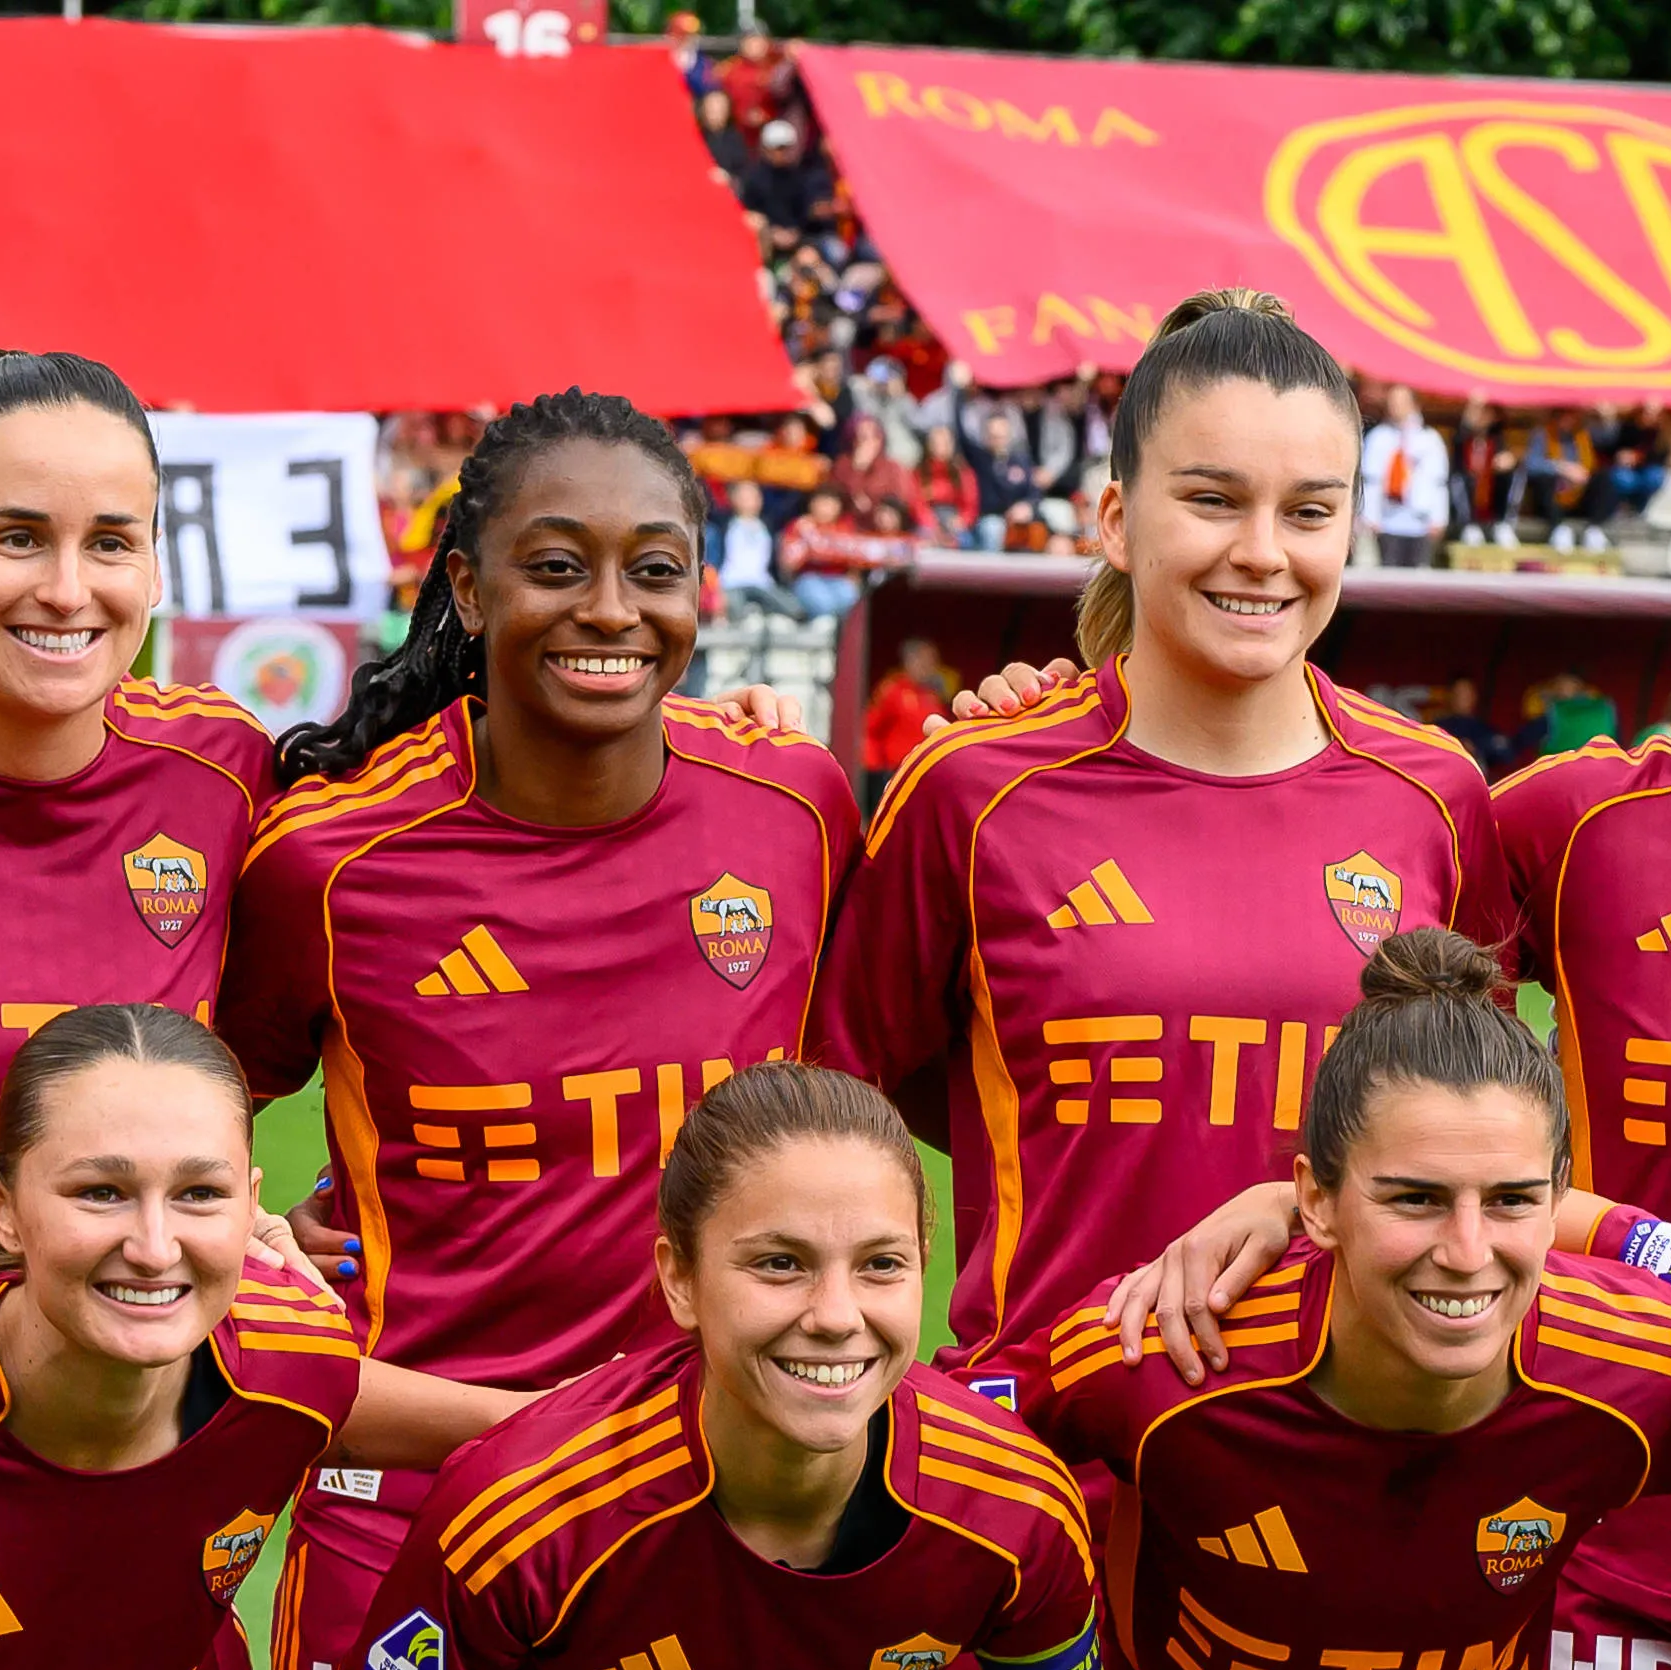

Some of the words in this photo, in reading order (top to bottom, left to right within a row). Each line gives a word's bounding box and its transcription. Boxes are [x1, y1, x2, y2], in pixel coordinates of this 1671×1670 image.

[483, 9, 572, 58] 16
[855, 72, 1162, 147] ROMA
[287, 458, 351, 606] 3
[141, 896, 200, 915] ROMA
[159, 919, 183, 932] 1927
[1341, 908, 1394, 932] ROMA
[1358, 932, 1379, 943] 1927
[708, 939, 766, 960] ROMA
[727, 960, 751, 973] 1927
[1189, 1015, 1343, 1131] TI
[1624, 1234, 1642, 1266] ATHO
[1485, 1552, 1545, 1575] ROMA
[1500, 1574, 1525, 1588] 1927
